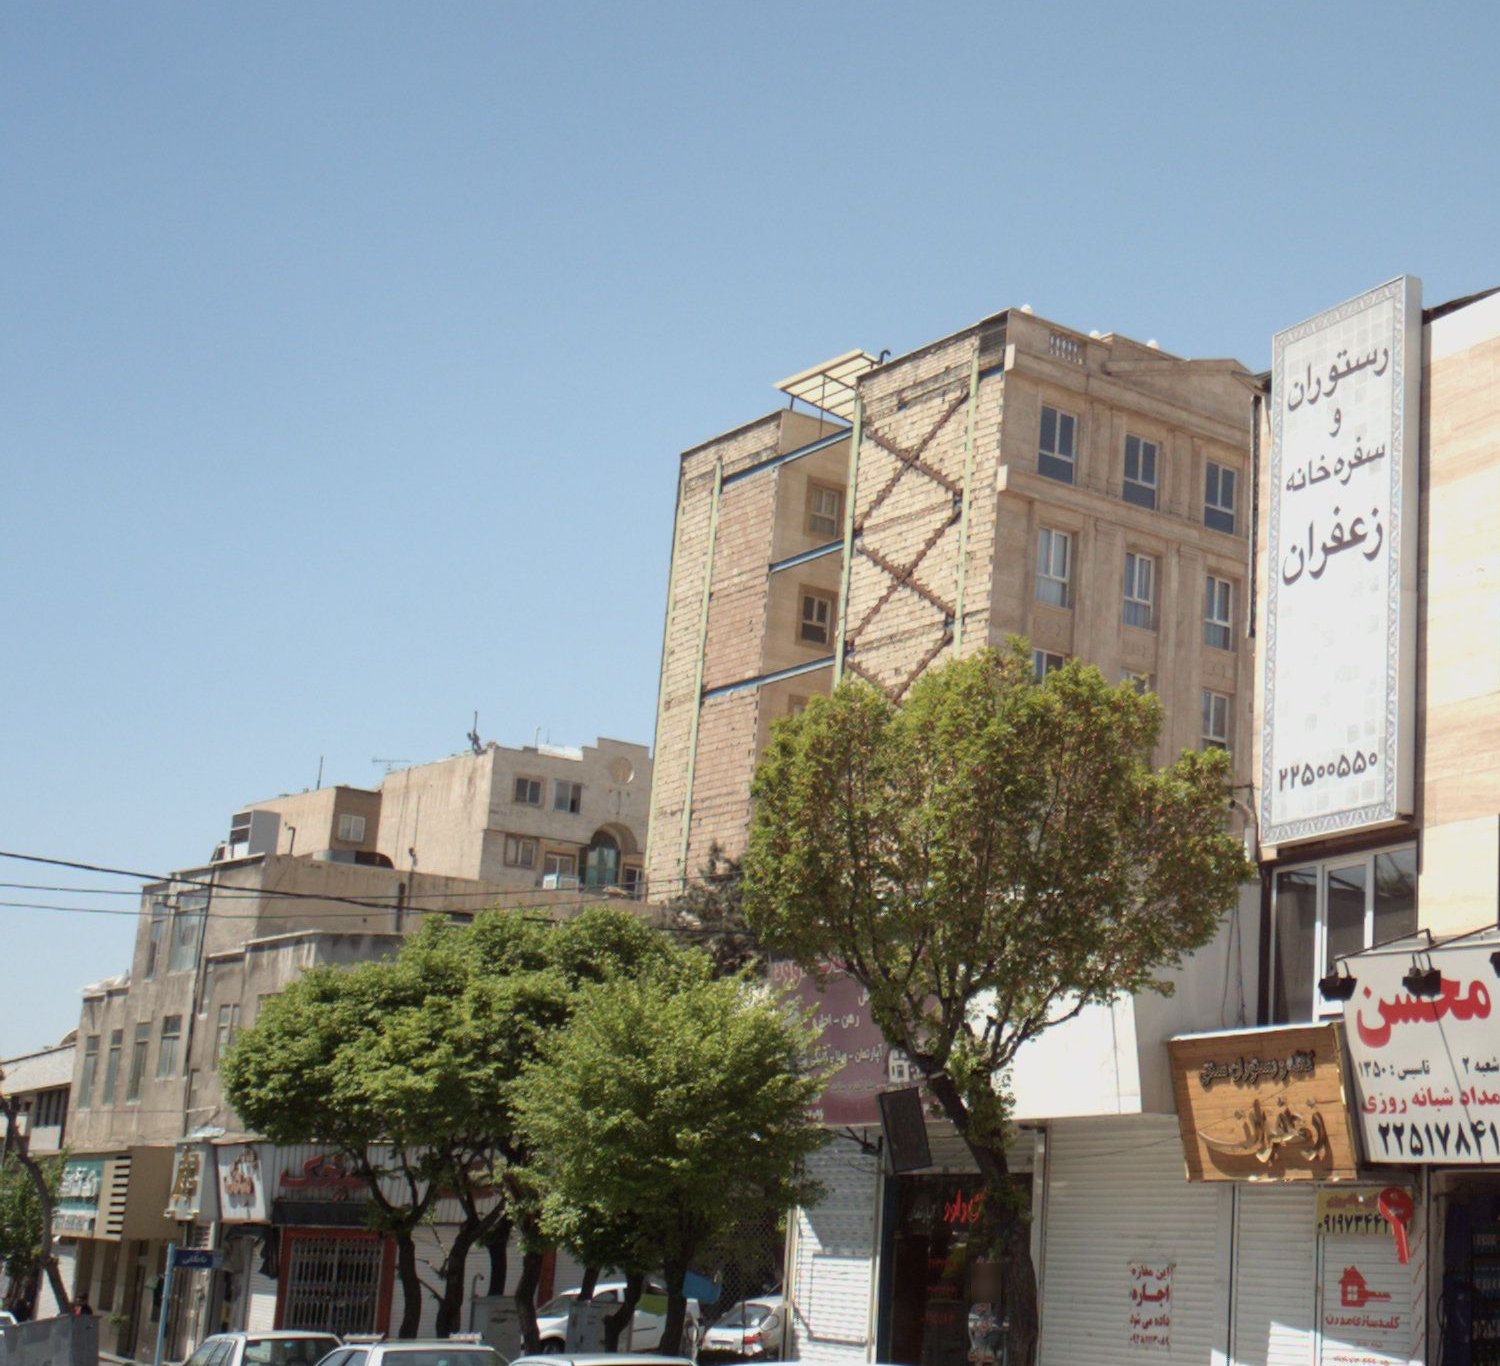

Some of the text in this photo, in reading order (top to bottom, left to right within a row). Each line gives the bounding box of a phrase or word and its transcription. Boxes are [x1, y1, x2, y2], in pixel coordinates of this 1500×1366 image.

[1287, 347, 1389, 411] رستوران
[1329, 407, 1342, 437] و
[1282, 506, 1383, 585] زعفران
[1278, 753, 1378, 792] ۲۲۵۰۰۵۵۰
[1356, 970, 1492, 1048] محسن
[1475, 1057, 1500, 1077] شعبه
[1378, 1120, 1500, 1156] ۲۲۵۱۷۸۴۱
